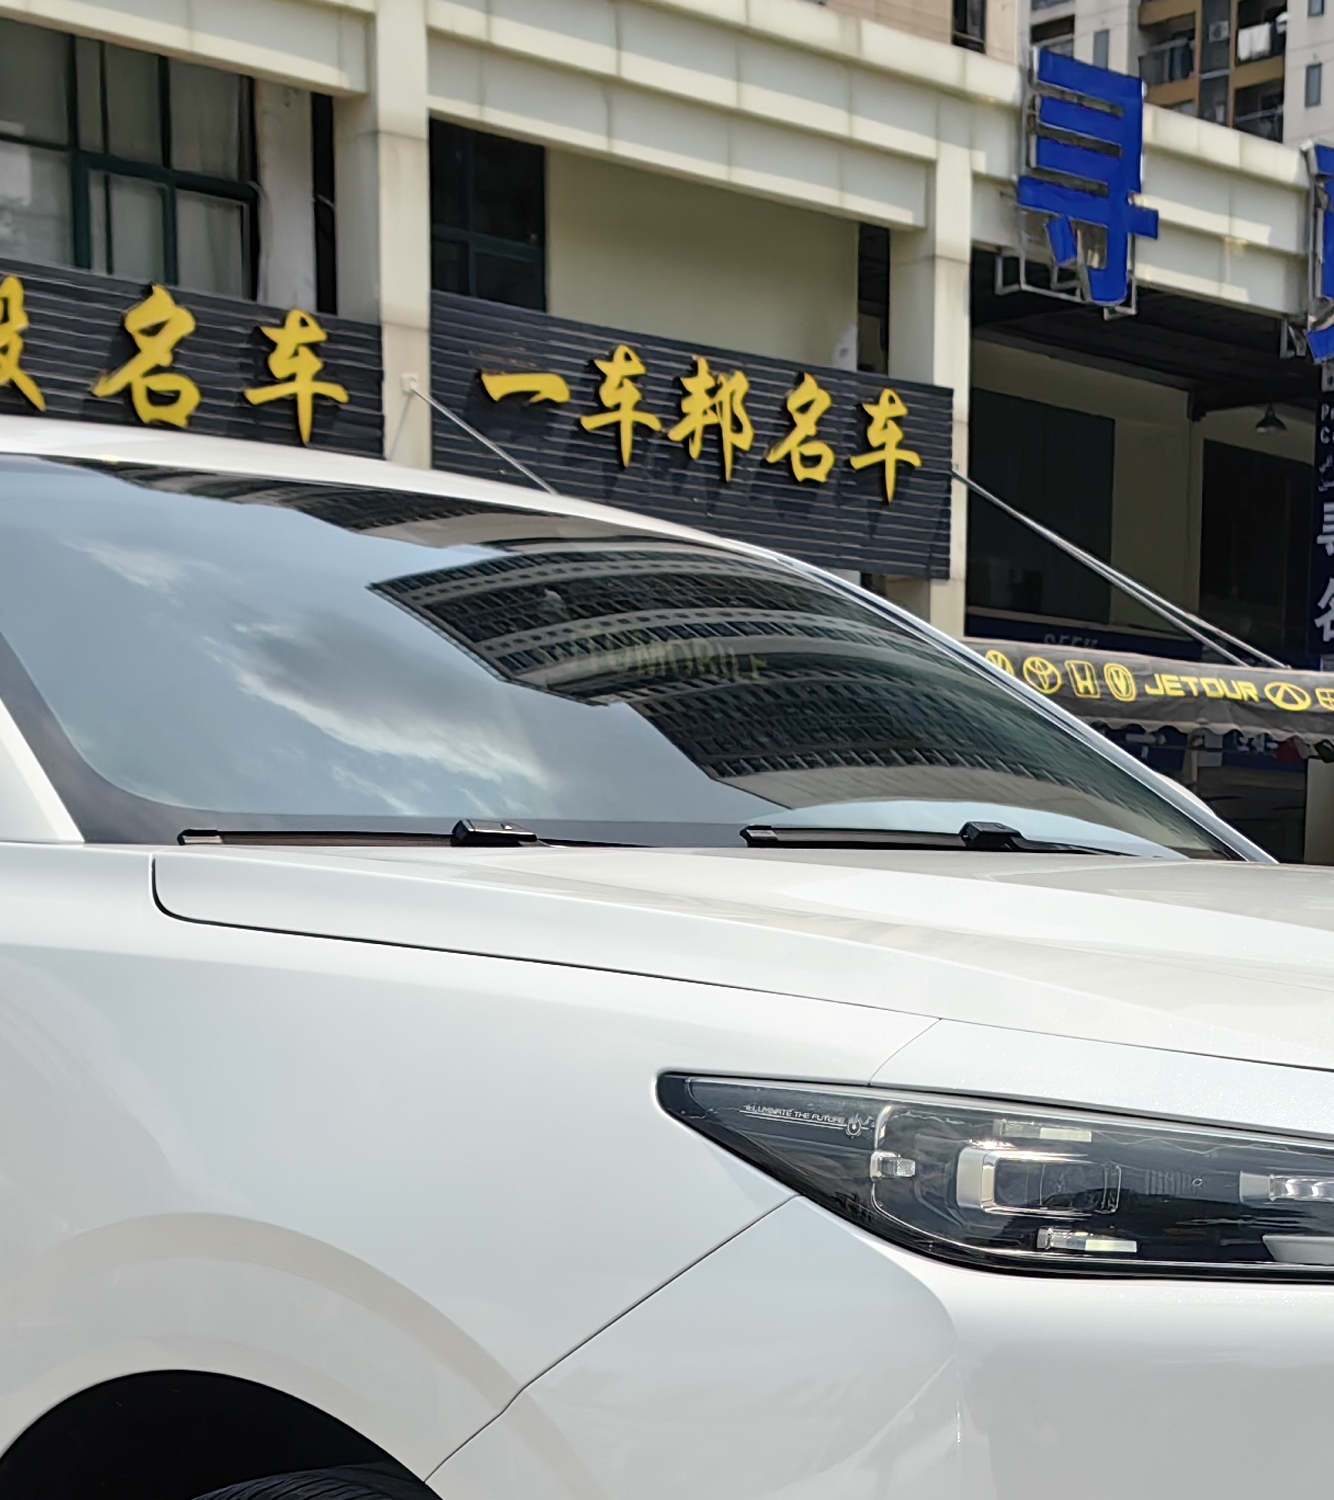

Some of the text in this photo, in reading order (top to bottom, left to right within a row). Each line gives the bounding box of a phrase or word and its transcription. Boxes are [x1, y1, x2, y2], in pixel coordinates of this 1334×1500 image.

[479, 344, 923, 503] 一车邦名车
[1144, 673, 1260, 703] JETOUR
